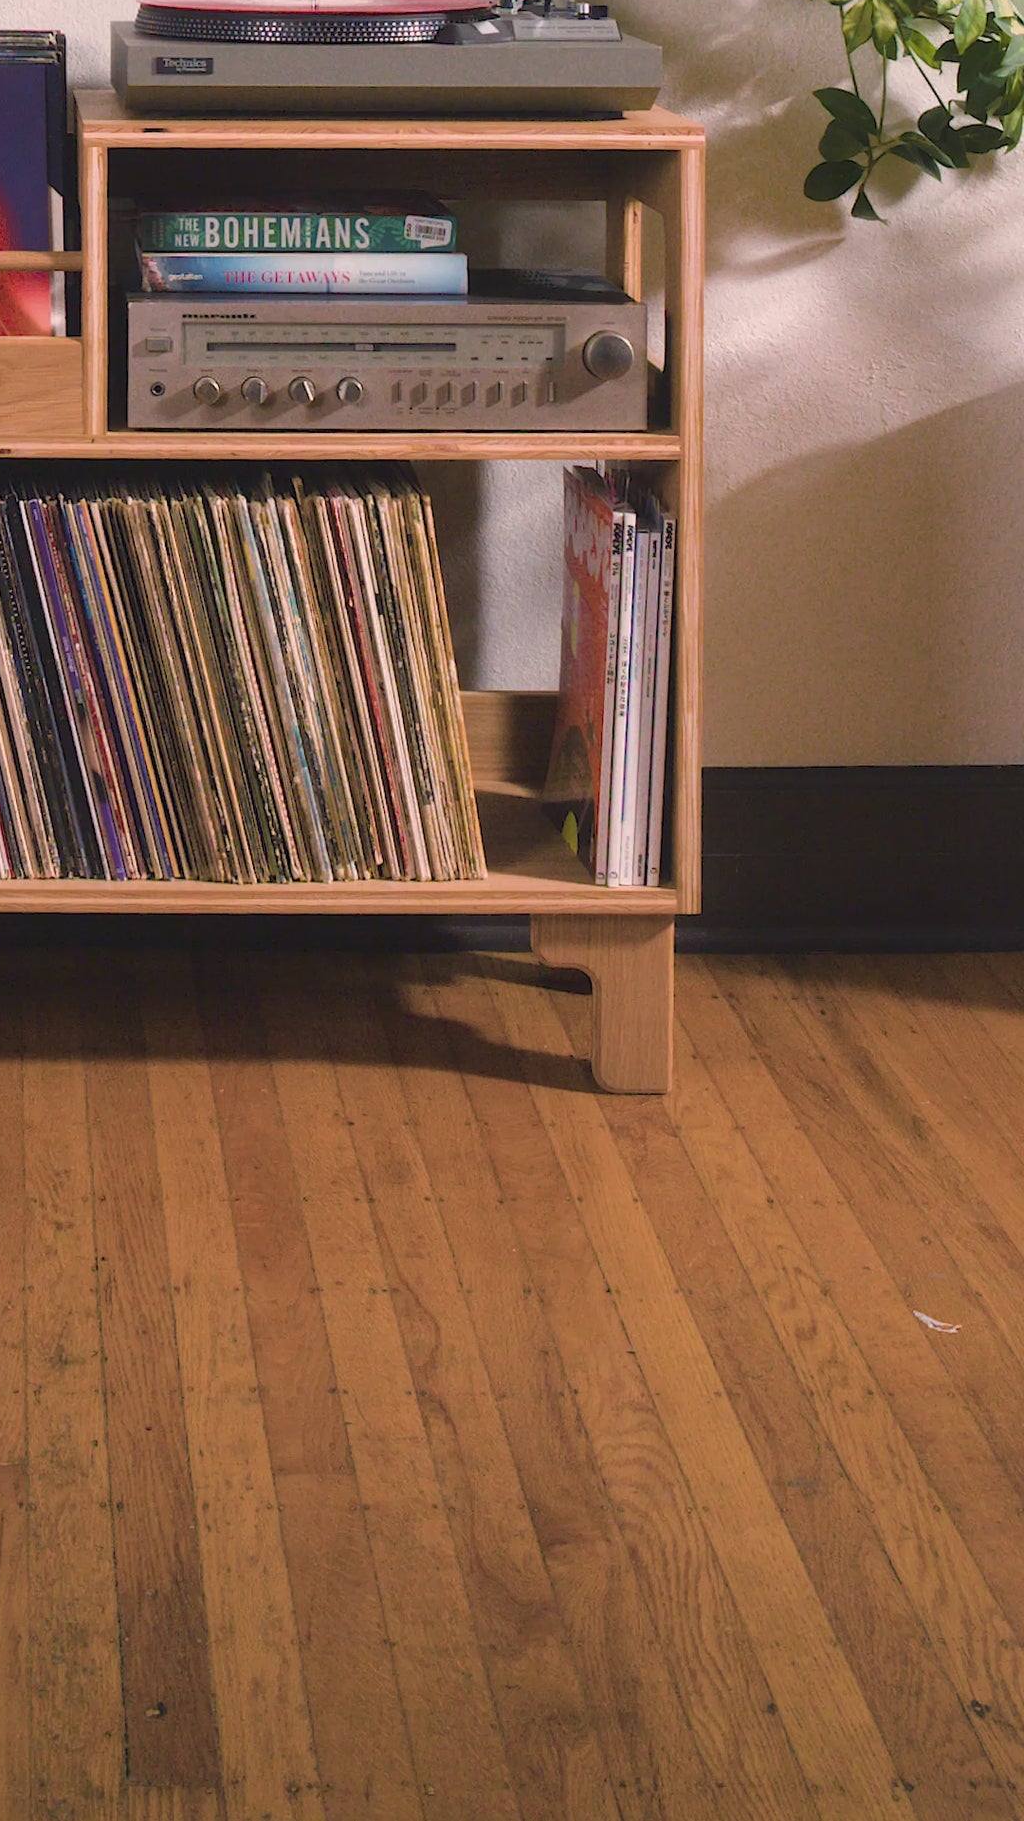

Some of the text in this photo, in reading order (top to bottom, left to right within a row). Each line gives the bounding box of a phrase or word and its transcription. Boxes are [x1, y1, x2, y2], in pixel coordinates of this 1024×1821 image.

[162, 58, 207, 68] Technics
[178, 217, 200, 232] THE
[204, 216, 371, 249] BOHEMIANS
[174, 233, 200, 248] NEW
[224, 269, 351, 285] THE GETAWAYS
